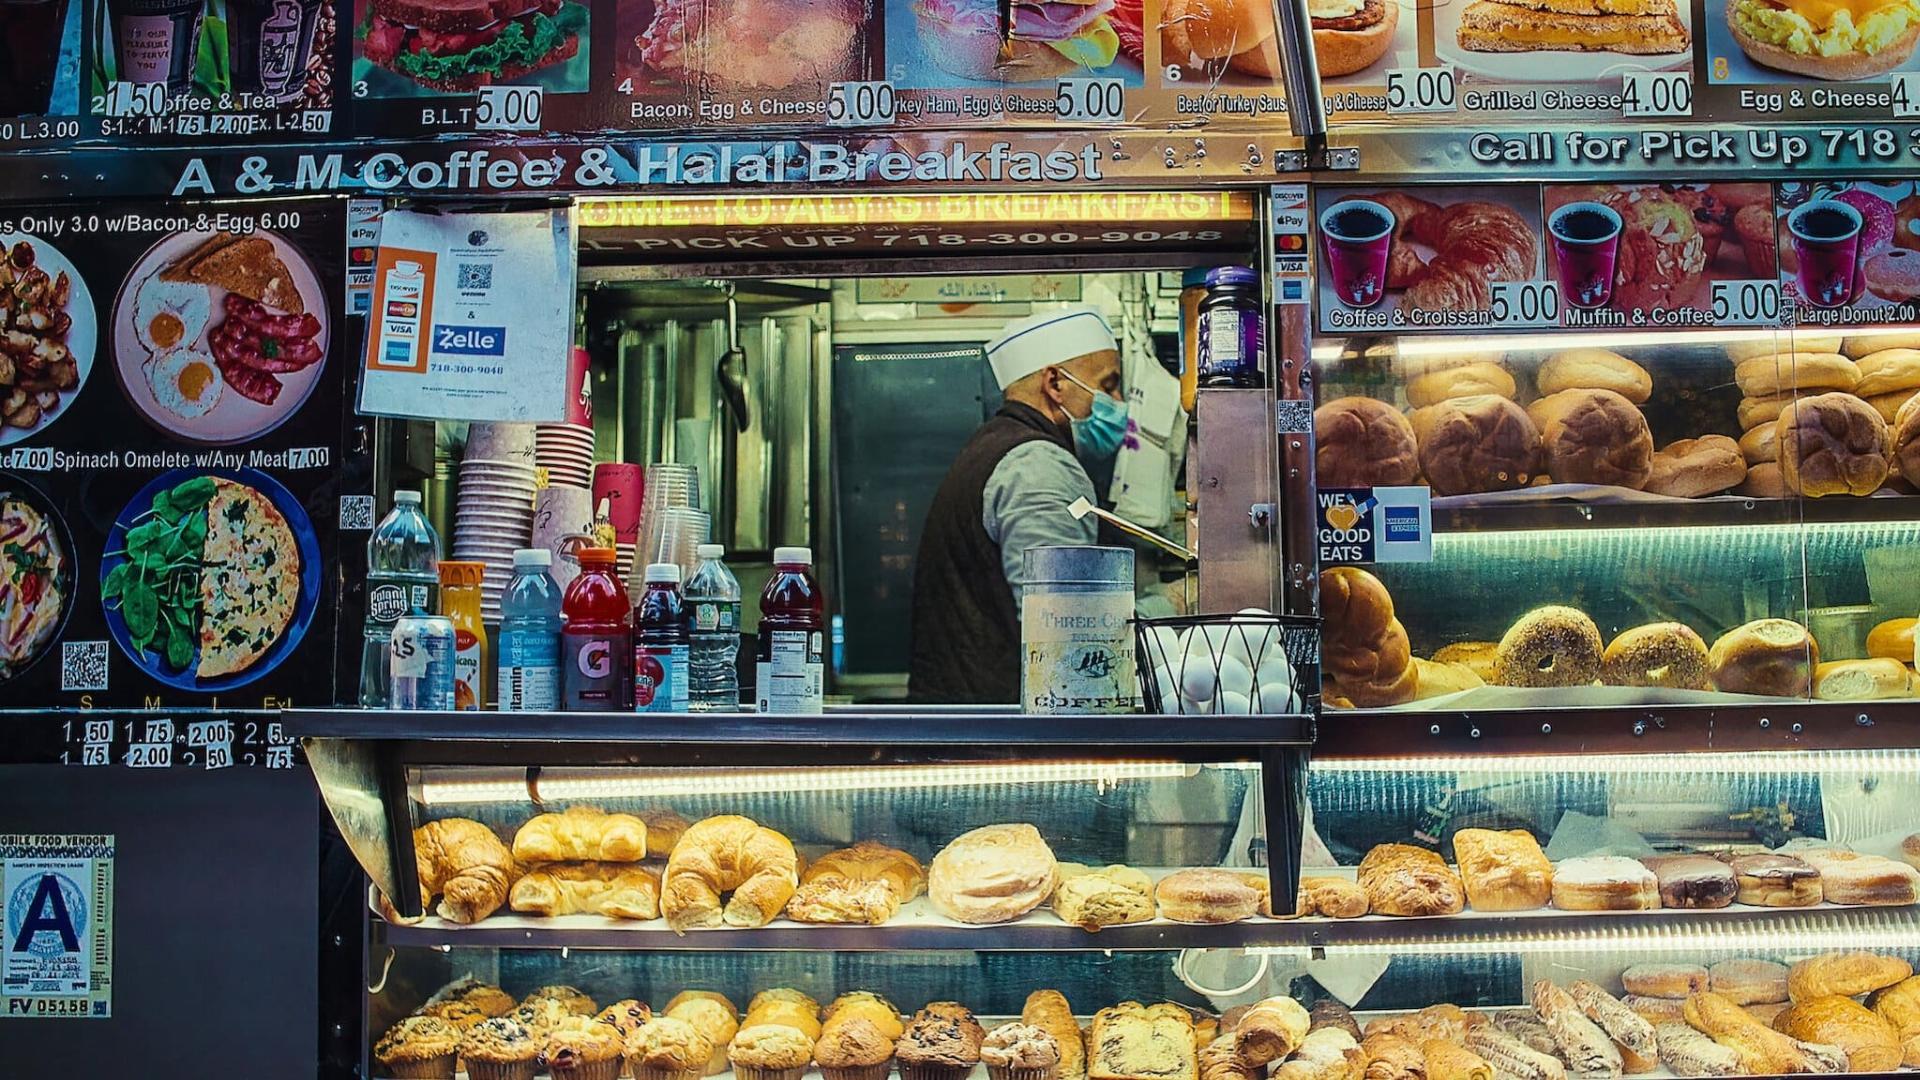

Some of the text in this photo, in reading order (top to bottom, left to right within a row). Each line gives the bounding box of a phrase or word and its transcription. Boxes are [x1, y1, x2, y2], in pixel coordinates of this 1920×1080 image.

[137, 61, 157, 69] YOU
[892, 65, 904, 80] 5
[1166, 65, 1181, 81] 6
[1714, 58, 1729, 80] 8
[354, 82, 368, 98] 3
[618, 79, 632, 96] 4
[1178, 95, 1203, 112] Beef
[1205, 97, 1218, 111] or
[1219, 95, 1257, 115] Turkey
[1335, 94, 1343, 108] &
[1387, 73, 1455, 107] 5.00
[1464, 77, 1690, 112] Grilled Cheese 4.00
[92, 96, 105, 113] 2
[107, 82, 166, 118] 1.50
[166, 94, 211, 111] offee
[219, 93, 233, 109] &
[422, 90, 541, 124] B.L.T 5.00
[631, 85, 893, 120] Bacon, Egg & Cheese 5.00
[895, 83, 1123, 117] rkey Ham, Egg & Cheese 5.00
[1741, 89, 1782, 112] Egg
[1789, 89, 1805, 107] &
[1812, 88, 1890, 107] Cheese
[1470, 132, 1553, 162] Call
[1566, 131, 1628, 160] for
[1641, 131, 1735, 160] Pick
[1748, 130, 1808, 163] Up
[1820, 129, 1896, 157] 718
[171, 141, 1103, 196] A & M Coffee & Halal Breakfast
[1275, 192, 1304, 200] DISCOVER
[583, 198, 690, 226] OME
[714, 197, 772, 225] TO
[940, 191, 1232, 222] BREAKFAST
[21, 216, 64, 238] Only
[71, 212, 99, 231] 3.0
[106, 209, 190, 231] w/Bacon
[196, 210, 210, 227] &
[217, 210, 255, 233] Egg
[261, 212, 301, 231] 6.00
[1285, 216, 1303, 227] Pay
[360, 228, 377, 241] Pay
[634, 236, 768, 251] PICK
[782, 235, 856, 249] UP
[873, 230, 1223, 247] 718-300-9048
[1281, 262, 1303, 272] VISA
[1330, 284, 1559, 327] Coffee & Croissan 5.00
[1565, 283, 1779, 326] Muffin & Coffee 5.00
[467, 311, 475, 320] &
[1800, 304, 1915, 326] Large Donut 2.00
[391, 325, 413, 334] VISA
[439, 328, 495, 349] Zelle
[430, 363, 504, 376] 718-300-9048
[14, 450, 48, 469] 7.00
[54, 451, 118, 472] Spinach
[124, 450, 190, 468] Omelete
[195, 449, 244, 472] w/Any
[249, 449, 287, 467] Meat
[293, 448, 328, 467] 7.00
[1318, 493, 1345, 508] WE
[1320, 528, 1371, 544] GOOD
[1320, 546, 1363, 561] EATS
[371, 586, 407, 604] Poland
[371, 598, 409, 617] Spring
[1041, 610, 1097, 629] THREE
[578, 640, 611, 679] G
[81, 695, 93, 710] S
[145, 696, 161, 710] M
[1034, 696, 1136, 709] COFFE
[1, 836, 107, 846] OBILE FOOD VENDOR
[12, 874, 81, 953] A
[9, 998, 88, 1014] FV 05158
